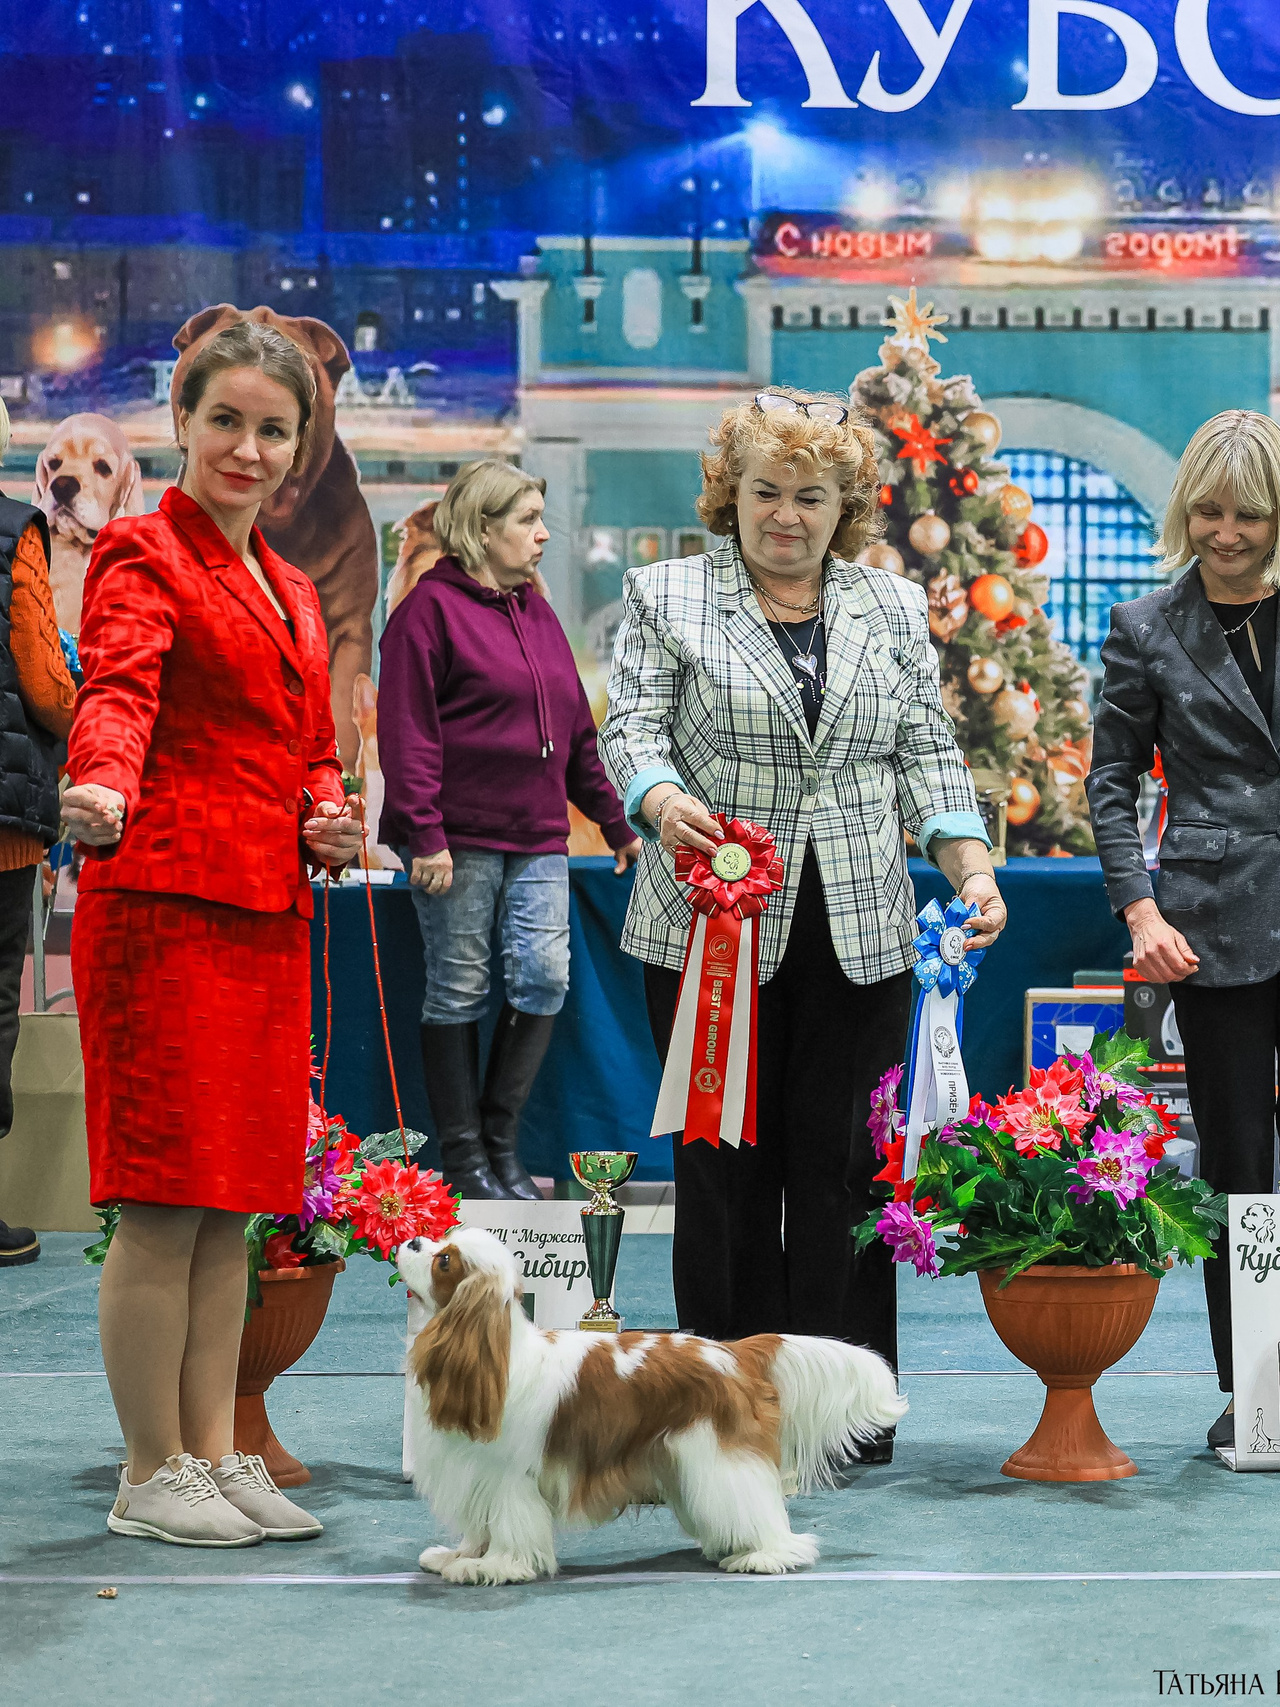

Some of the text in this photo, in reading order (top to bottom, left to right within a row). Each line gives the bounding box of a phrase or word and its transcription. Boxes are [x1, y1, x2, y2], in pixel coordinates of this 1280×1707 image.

[710, 979, 723, 1008] BEST
[709, 1009, 721, 1022] IN
[705, 1025, 718, 1064] GROUP
[704, 1074, 713, 1087] 1
[512, 1228, 585, 1249] “Мэджест
[513, 1250, 591, 1290] ибир
